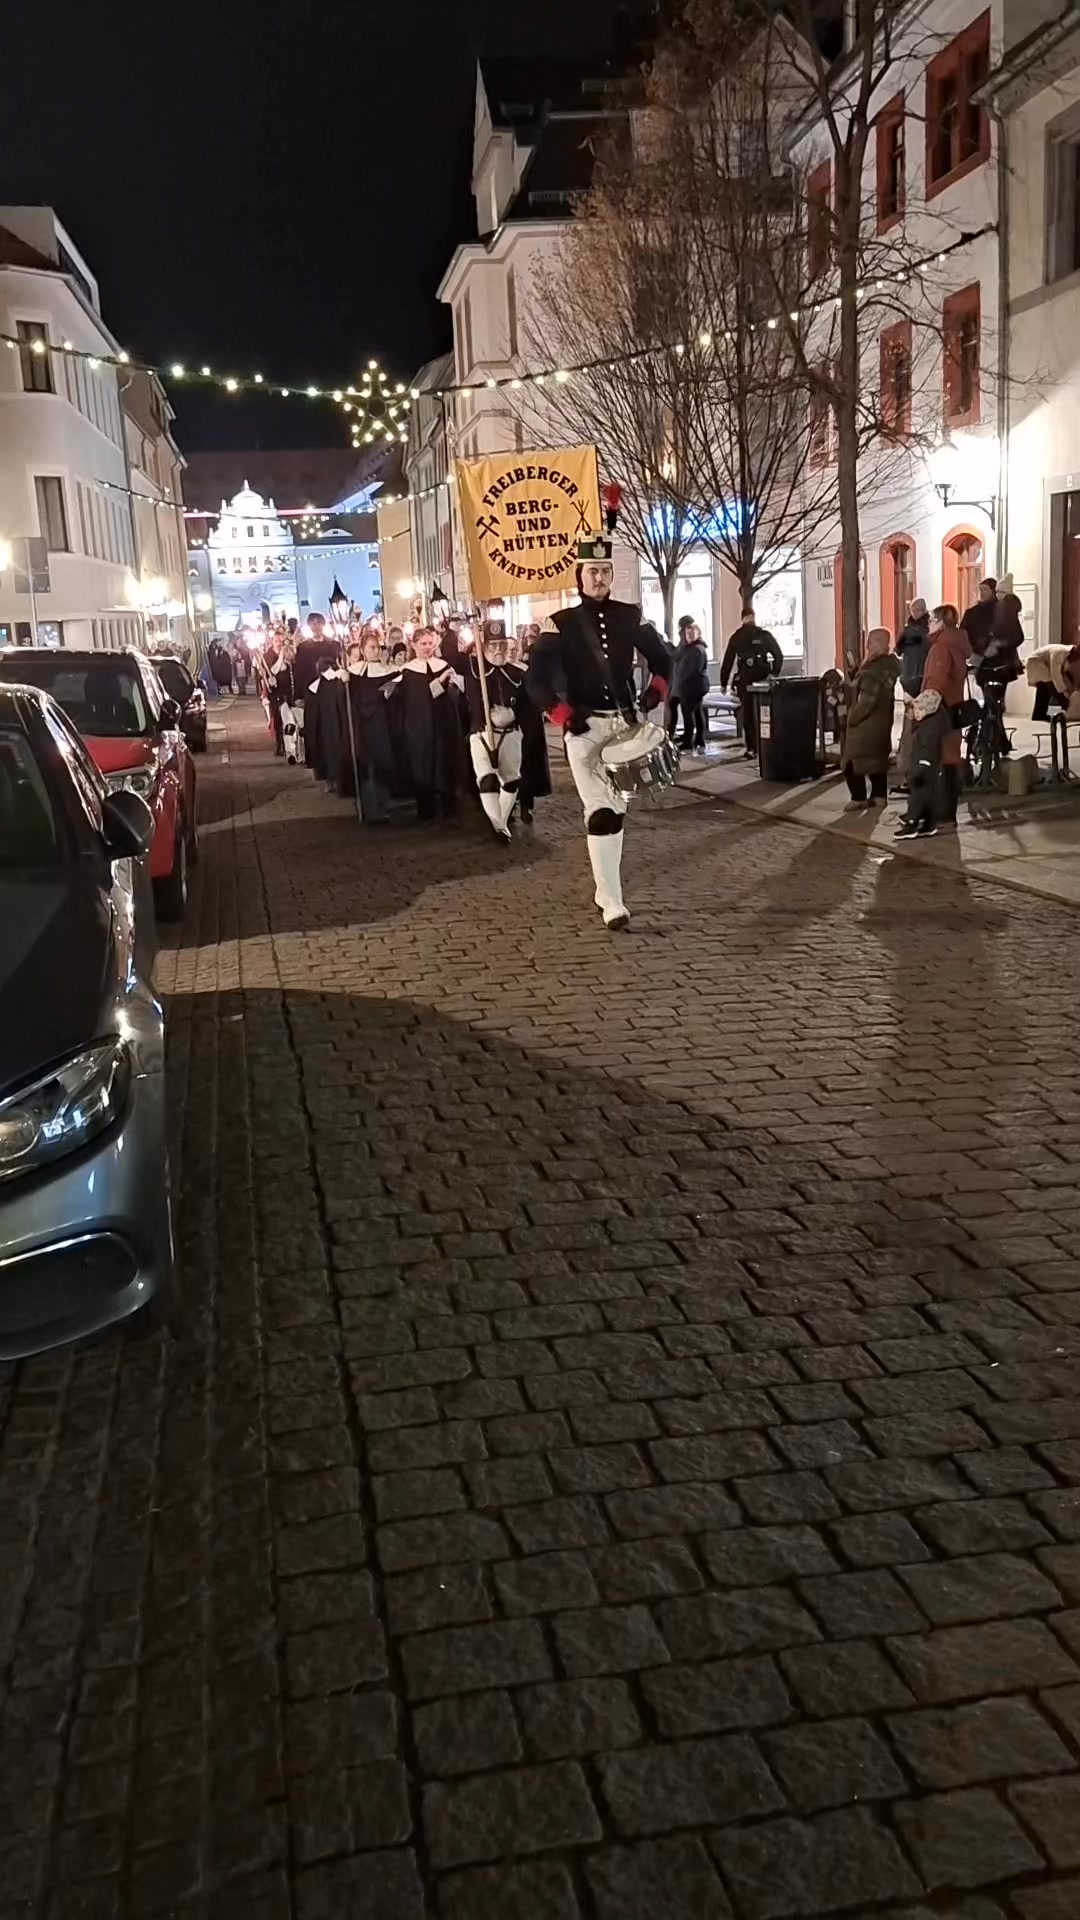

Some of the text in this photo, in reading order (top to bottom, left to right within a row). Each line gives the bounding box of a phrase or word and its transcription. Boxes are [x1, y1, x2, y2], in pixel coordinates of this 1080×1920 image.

[482, 466, 579, 508] FREIBERGER
[505, 498, 559, 516] BERG-
[517, 517, 551, 532] UND
[503, 533, 569, 552] HÜTTEN
